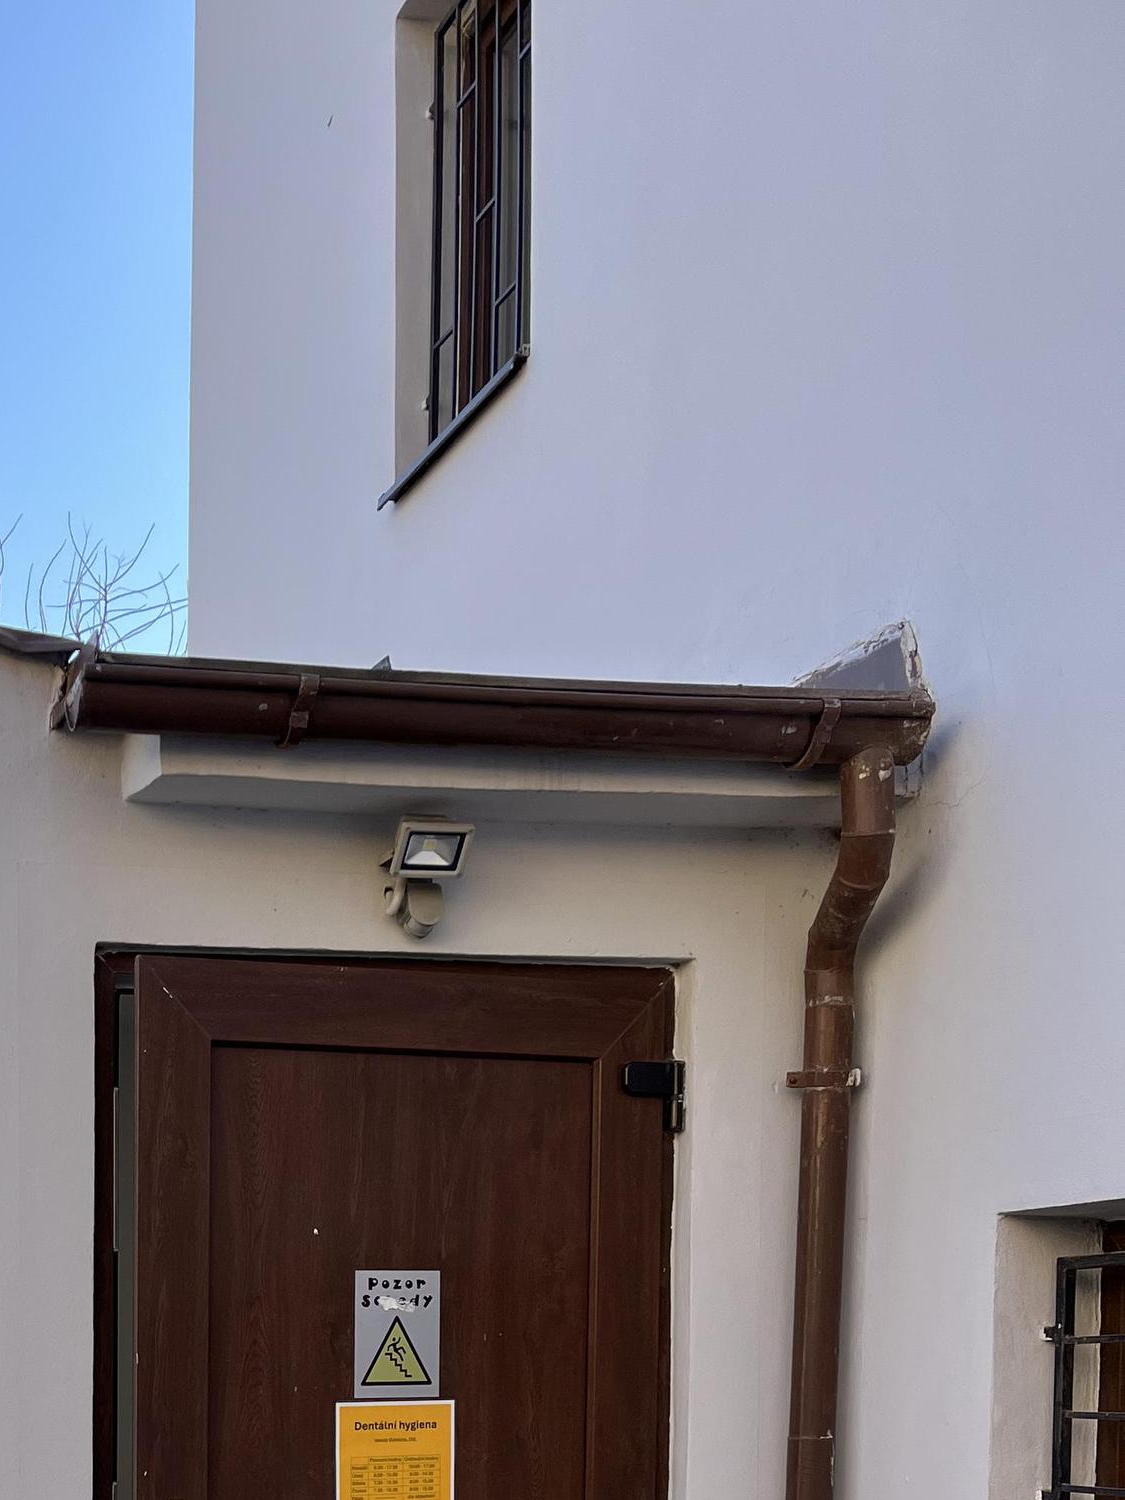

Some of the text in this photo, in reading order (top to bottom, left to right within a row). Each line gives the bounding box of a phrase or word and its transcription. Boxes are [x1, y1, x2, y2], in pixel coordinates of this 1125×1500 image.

[368, 1277, 426, 1290] Pozor
[354, 1419, 437, 1432] Dentální hygiena
